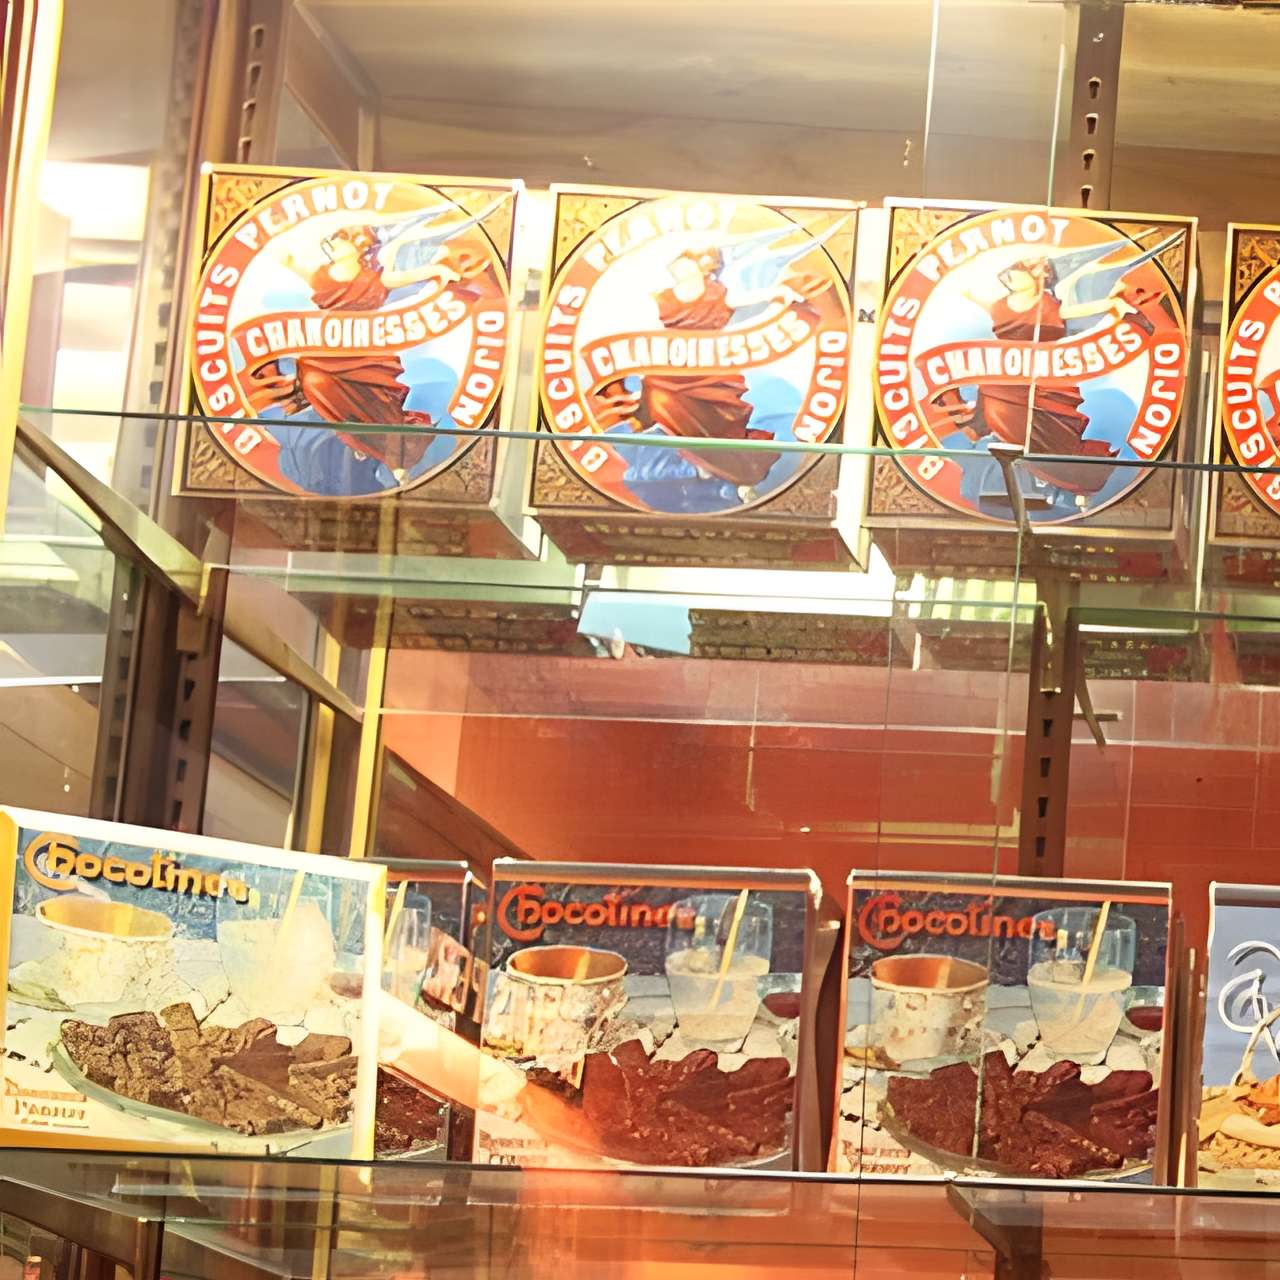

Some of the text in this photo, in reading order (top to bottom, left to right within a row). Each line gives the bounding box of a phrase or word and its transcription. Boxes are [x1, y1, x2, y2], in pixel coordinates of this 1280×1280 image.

[235, 181, 395, 250] PERNOT
[917, 214, 1071, 282] PERNOT
[246, 291, 467, 357] CHANOINESSES
[450, 311, 506, 427] DIJON
[796, 331, 848, 443] DIJON
[1129, 343, 1181, 456] DIJON
